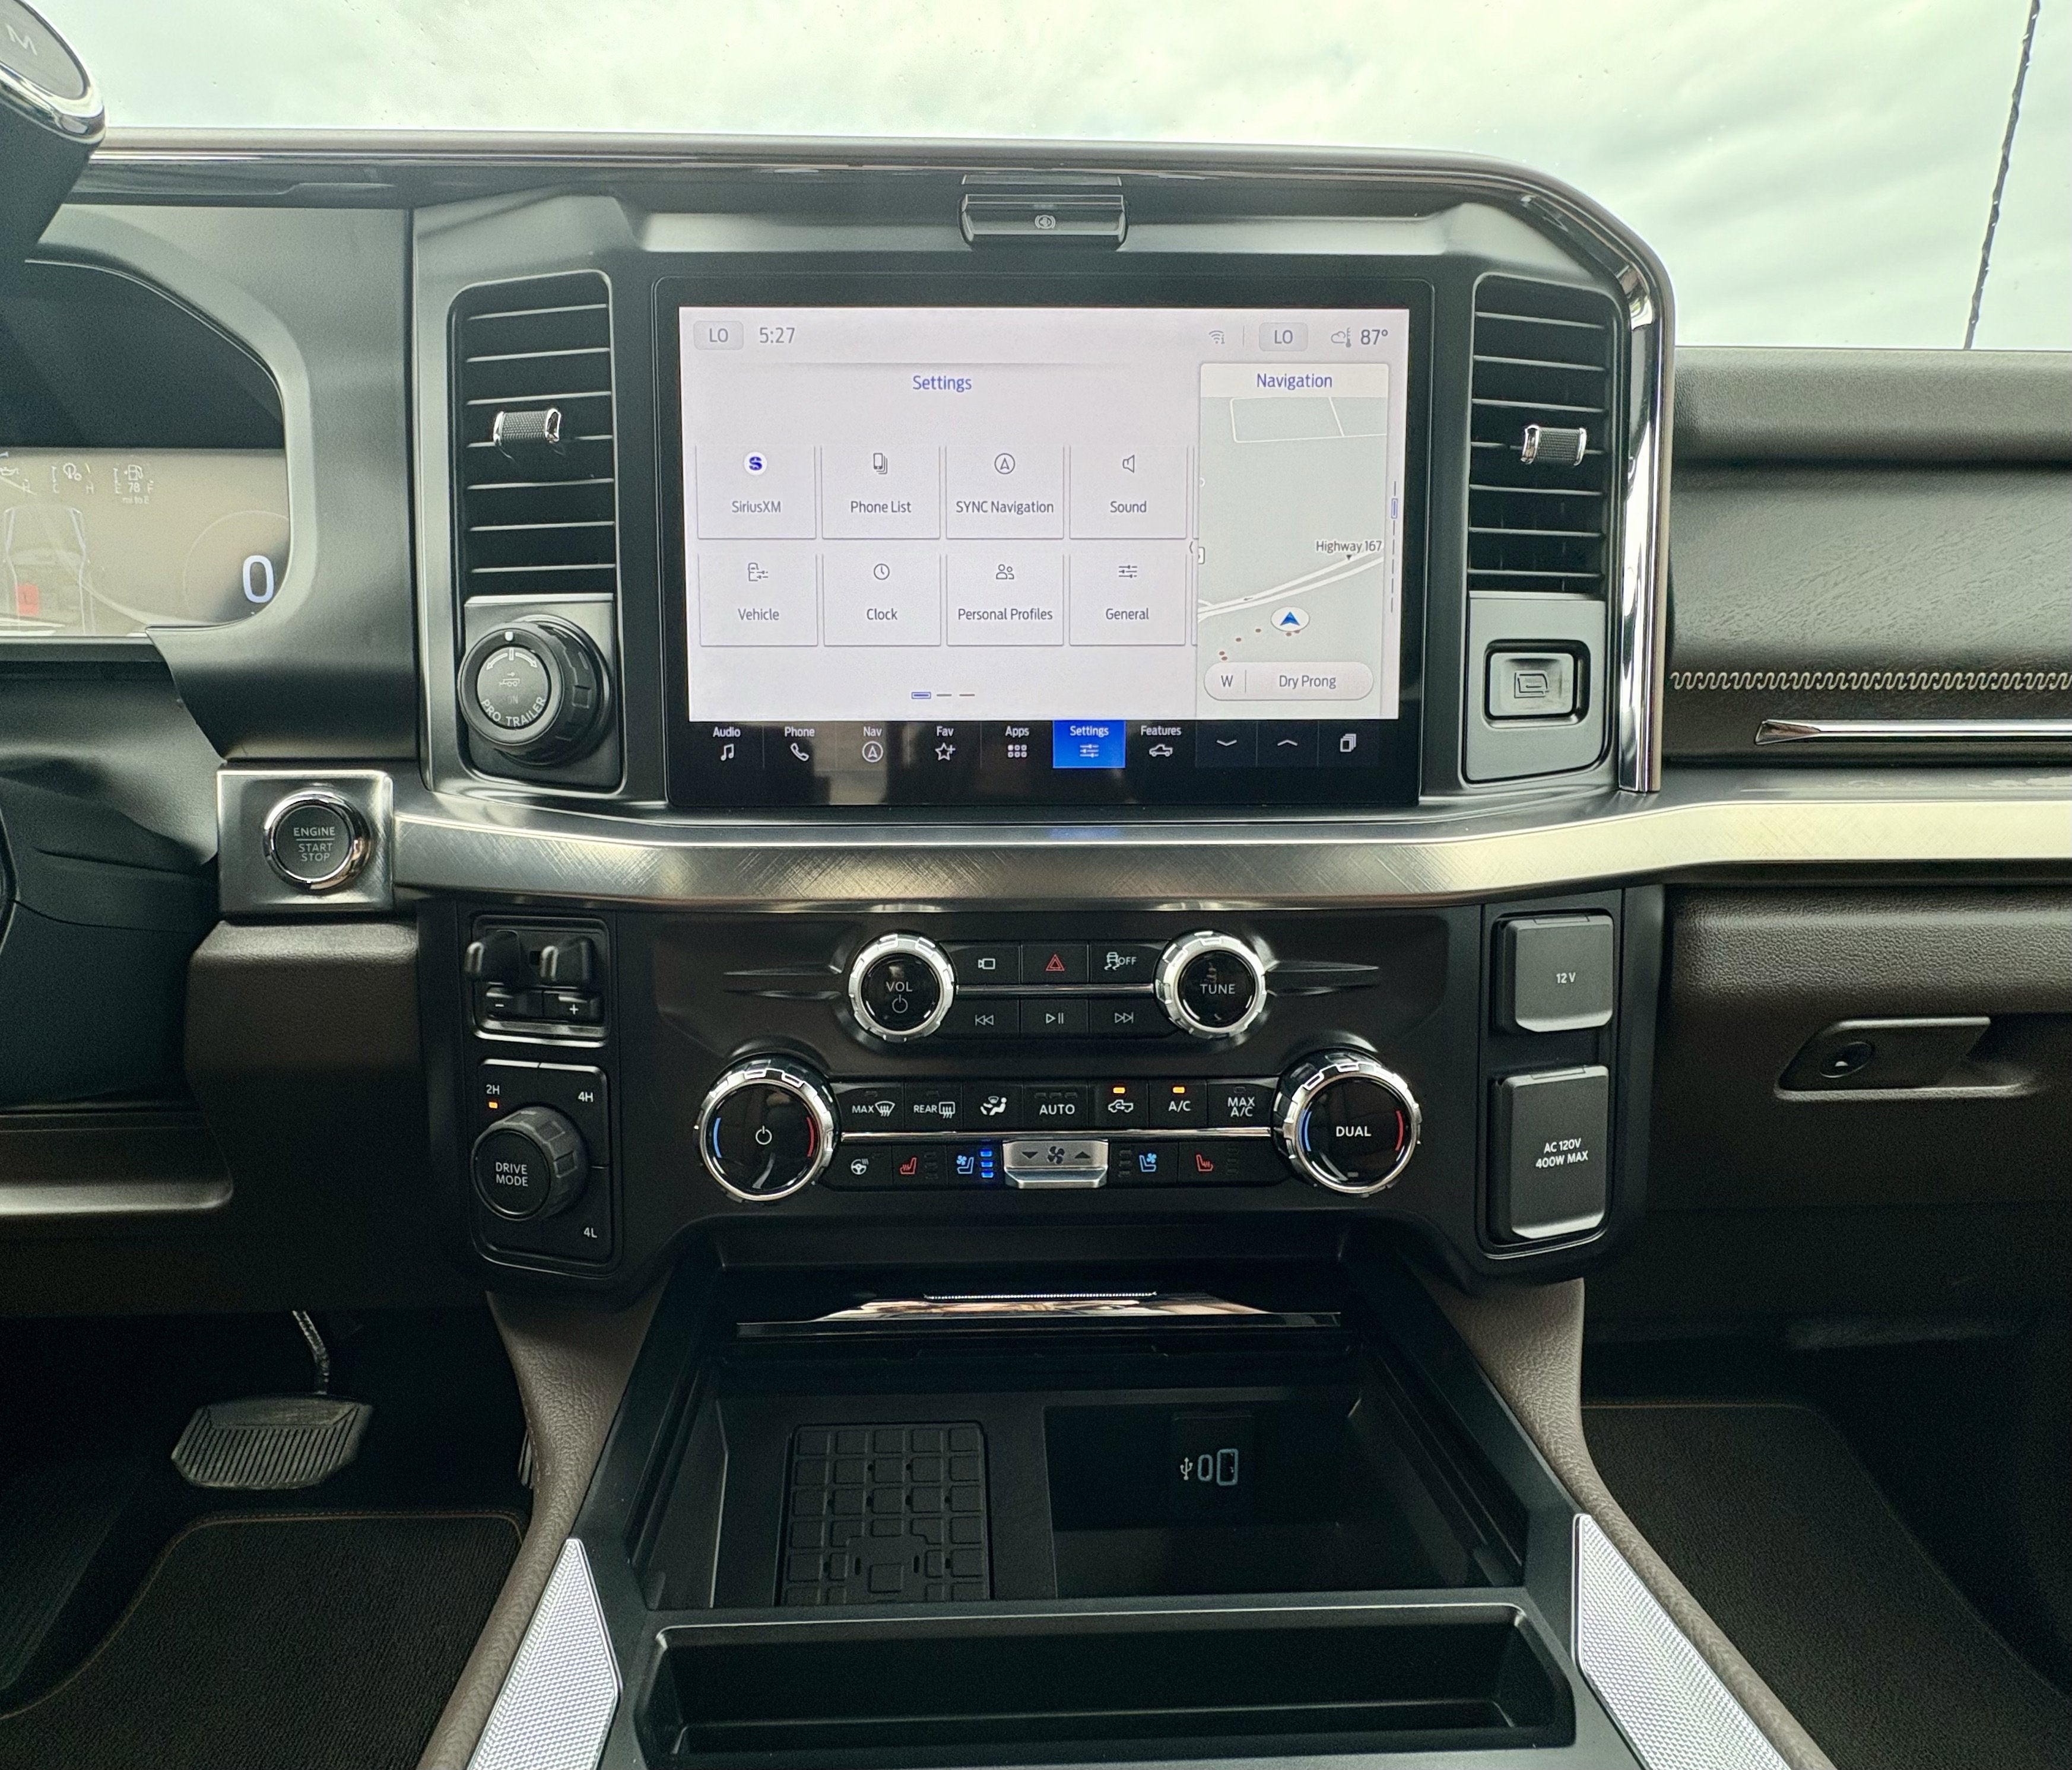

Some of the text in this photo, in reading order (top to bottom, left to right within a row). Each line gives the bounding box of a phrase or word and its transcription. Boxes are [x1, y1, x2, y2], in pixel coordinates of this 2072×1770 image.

[708, 328, 729, 343] LO
[759, 327, 795, 344] 5:27
[1274, 330, 1293, 345] LO
[1360, 329, 1389, 345] 87°
[912, 375, 972, 393] Settings
[1256, 373, 1333, 390] Navigation
[731, 500, 781, 514] SiriusXM
[850, 500, 912, 514] Phone List
[956, 500, 1054, 516] SYNC Navigation
[1109, 500, 1147, 514] Sound
[1315, 539, 1382, 555] Highway 167
[242, 555, 275, 603] 0
[737, 608, 780, 621] Vehicle
[866, 608, 898, 621] Clock
[957, 608, 1054, 621] Personal Profiles
[1105, 608, 1150, 621] General
[1220, 675, 1233, 688] W
[1278, 675, 1337, 690] Dry Prong
[481, 695, 546, 727] PRO TRAILER
[712, 726, 741, 738] Audio
[784, 726, 816, 738] Phone
[862, 726, 883, 738] Nav
[936, 725, 954, 738] Fav
[1004, 725, 1030, 739] Apps
[1070, 724, 1109, 739] Settings
[1140, 724, 1182, 737] Features
[293, 826, 336, 837] ENGINE
[299, 842, 334, 852] START
[301, 852, 331, 862] STOP
[1119, 957, 1137, 966] OFF
[886, 981, 913, 993] VOL
[1200, 983, 1236, 995] TUNE
[486, 1084, 500, 1095] 2H
[578, 1091, 594, 1103] 4H
[1227, 1096, 1255, 1107] MAX
[852, 1105, 874, 1114] MAX
[913, 1104, 938, 1114] REAR
[1039, 1104, 1075, 1116] AUTO
[1168, 1100, 1192, 1113] A/C
[1230, 1106, 1254, 1117] A/C
[1335, 1126, 1372, 1137] DUAL
[1543, 1137, 1582, 1154] AC 120V
[1535, 1150, 1589, 1169] 400W MAX
[495, 1161, 528, 1175] DRIVE
[496, 1173, 529, 1187] MODE
[583, 1227, 598, 1239] 4L
